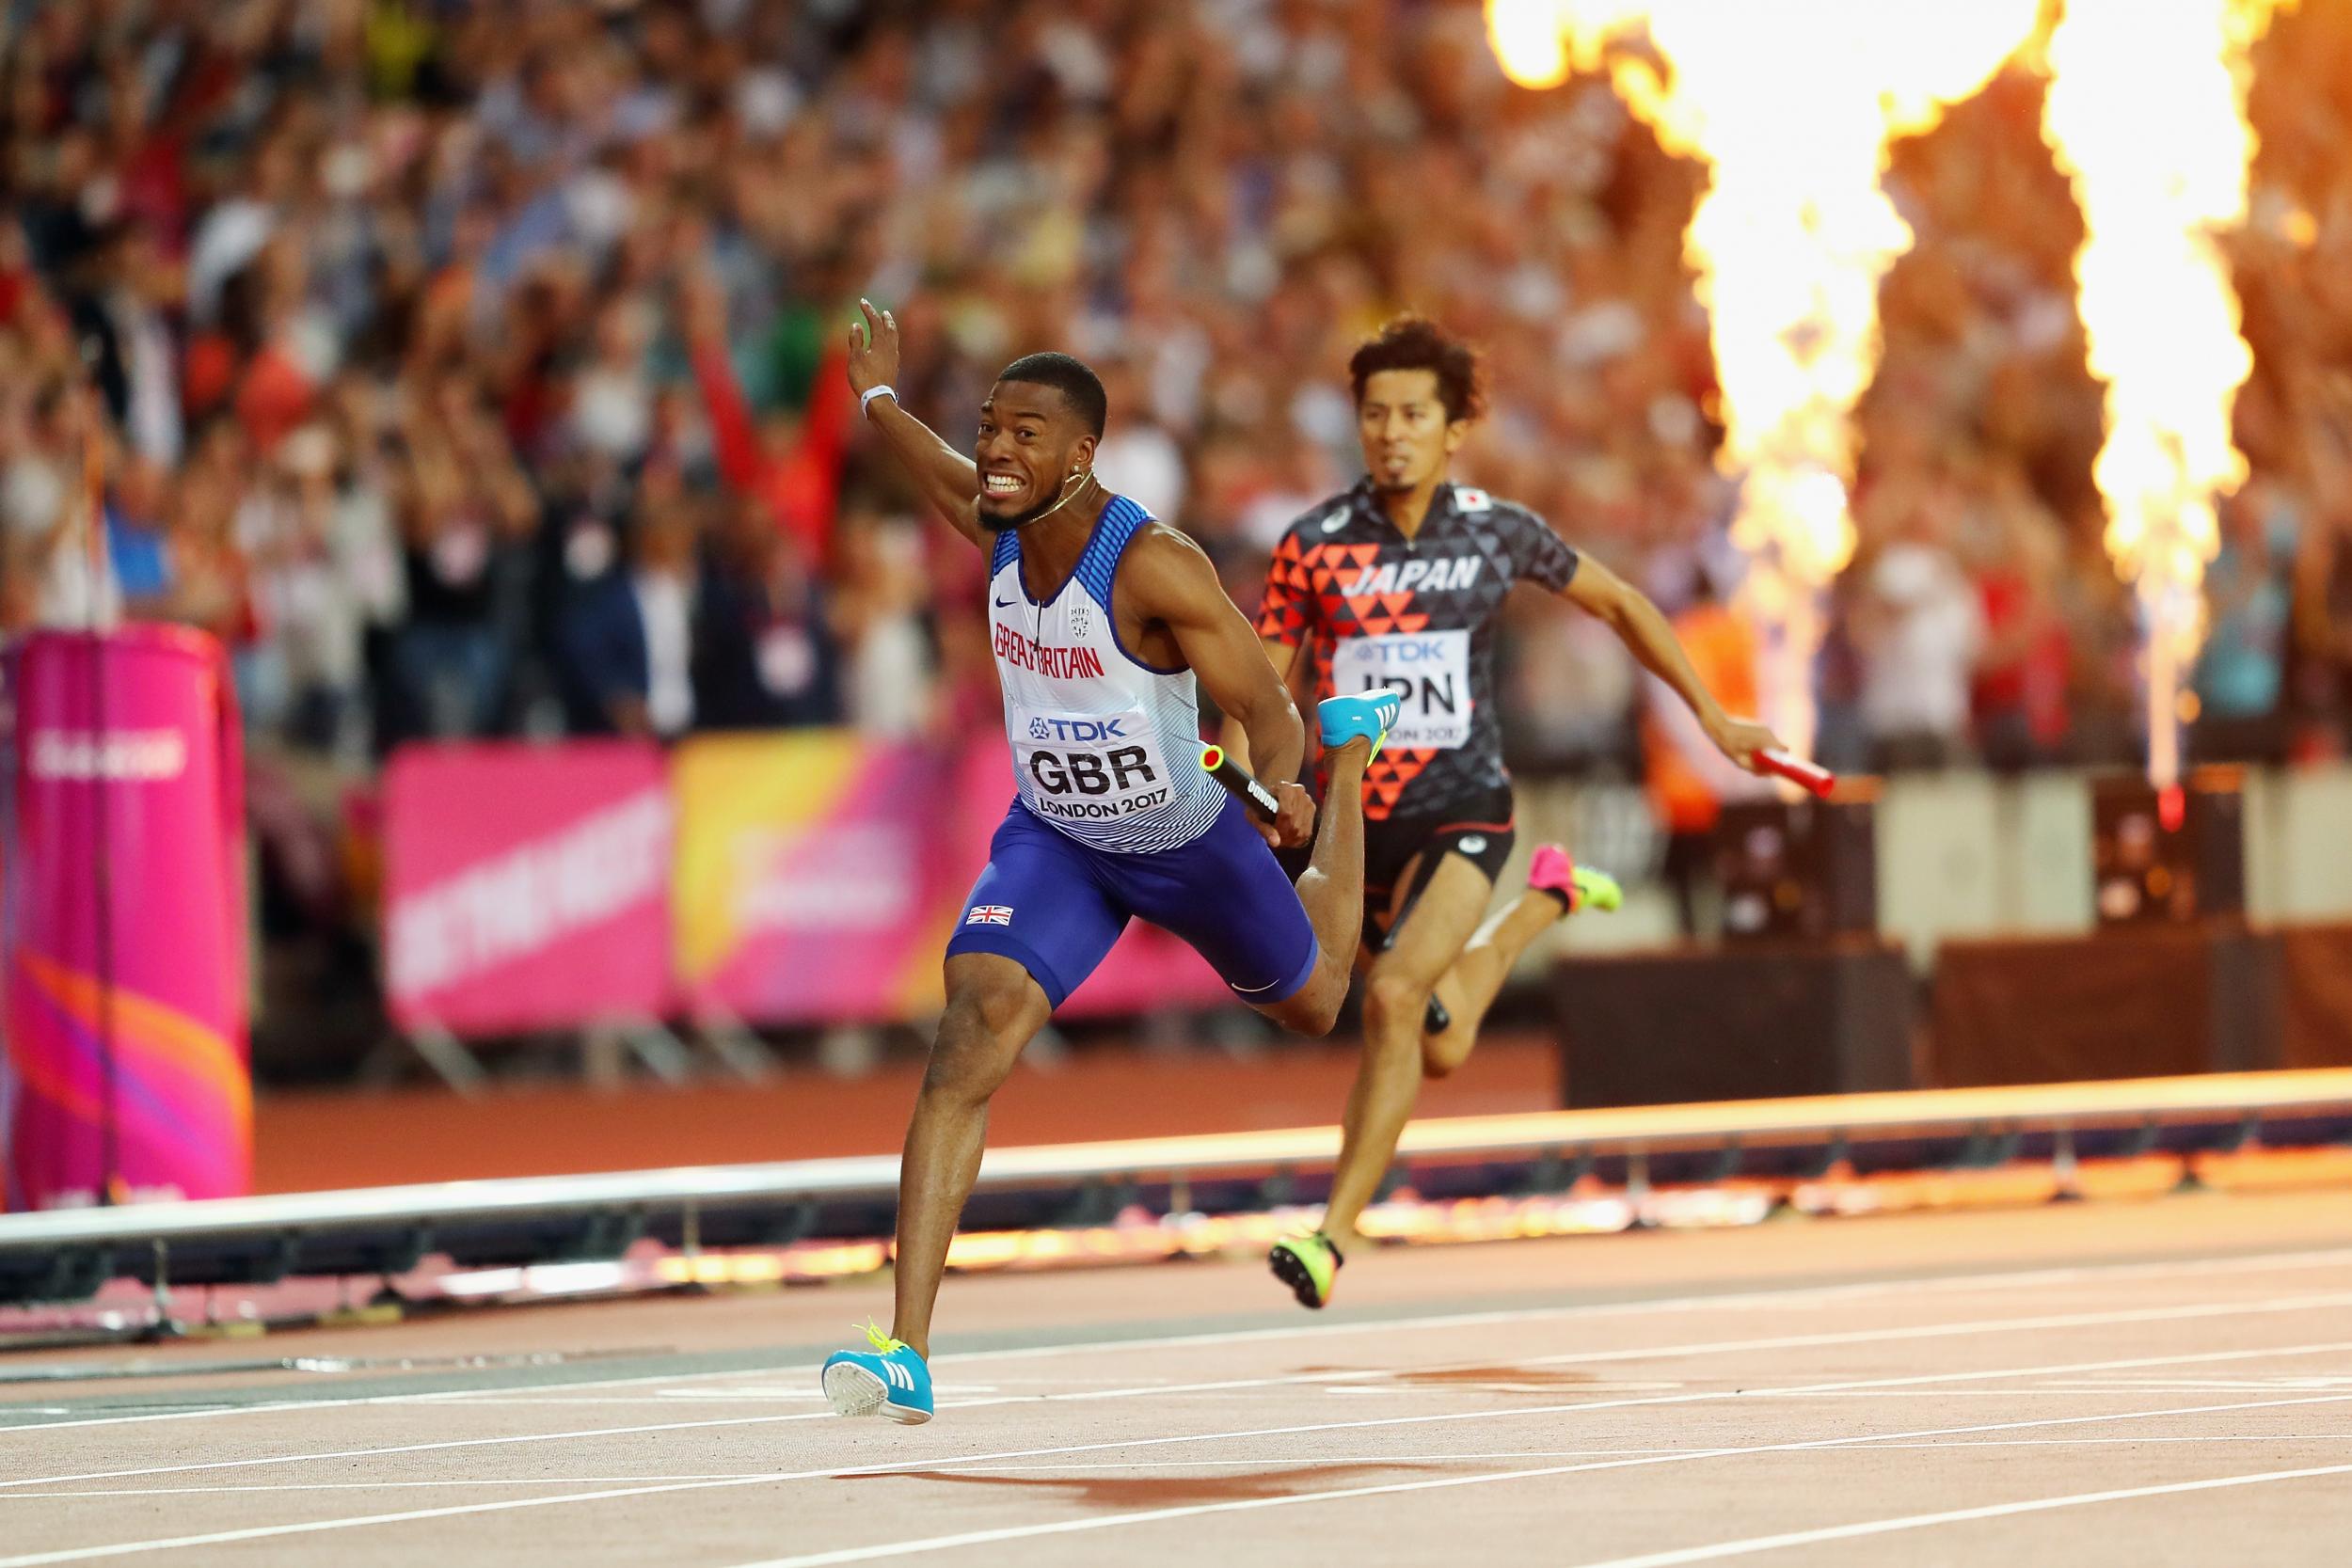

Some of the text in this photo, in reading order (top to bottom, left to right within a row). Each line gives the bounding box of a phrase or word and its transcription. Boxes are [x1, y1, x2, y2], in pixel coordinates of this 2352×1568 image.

[1341, 555, 1483, 597] JAPAN
[1037, 646, 1104, 679] BRITAIN
[1376, 640, 1444, 661] TDK
[1048, 719, 1127, 741] TDK
[1030, 745, 1156, 795] GBR
[1040, 787, 1168, 818] LONDON 2017
